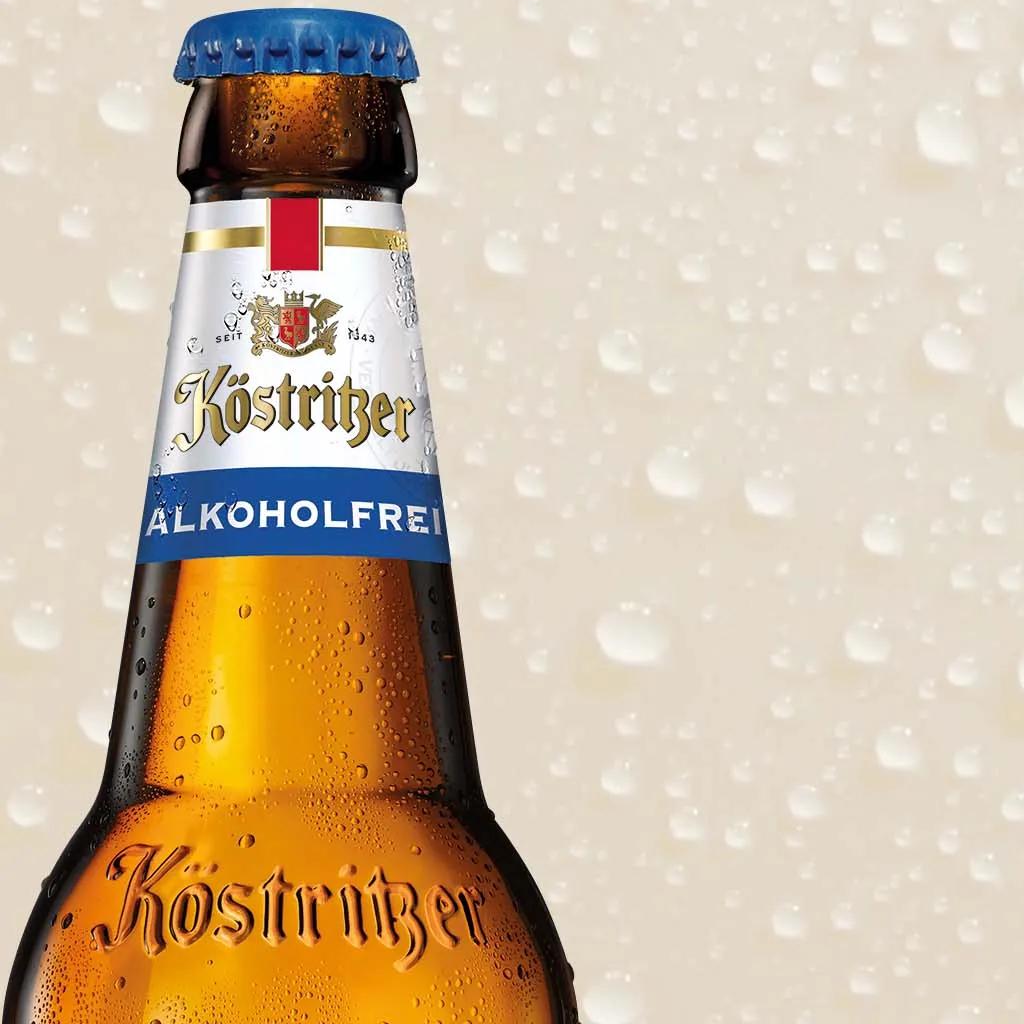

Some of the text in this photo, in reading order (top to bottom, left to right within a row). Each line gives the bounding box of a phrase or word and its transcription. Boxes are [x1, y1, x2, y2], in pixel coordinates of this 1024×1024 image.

[215, 332, 243, 343] SEIT
[173, 364, 416, 452] Köstritzer
[145, 499, 442, 536] ALKOHOLFREI
[91, 844, 488, 971] Köstritzer
